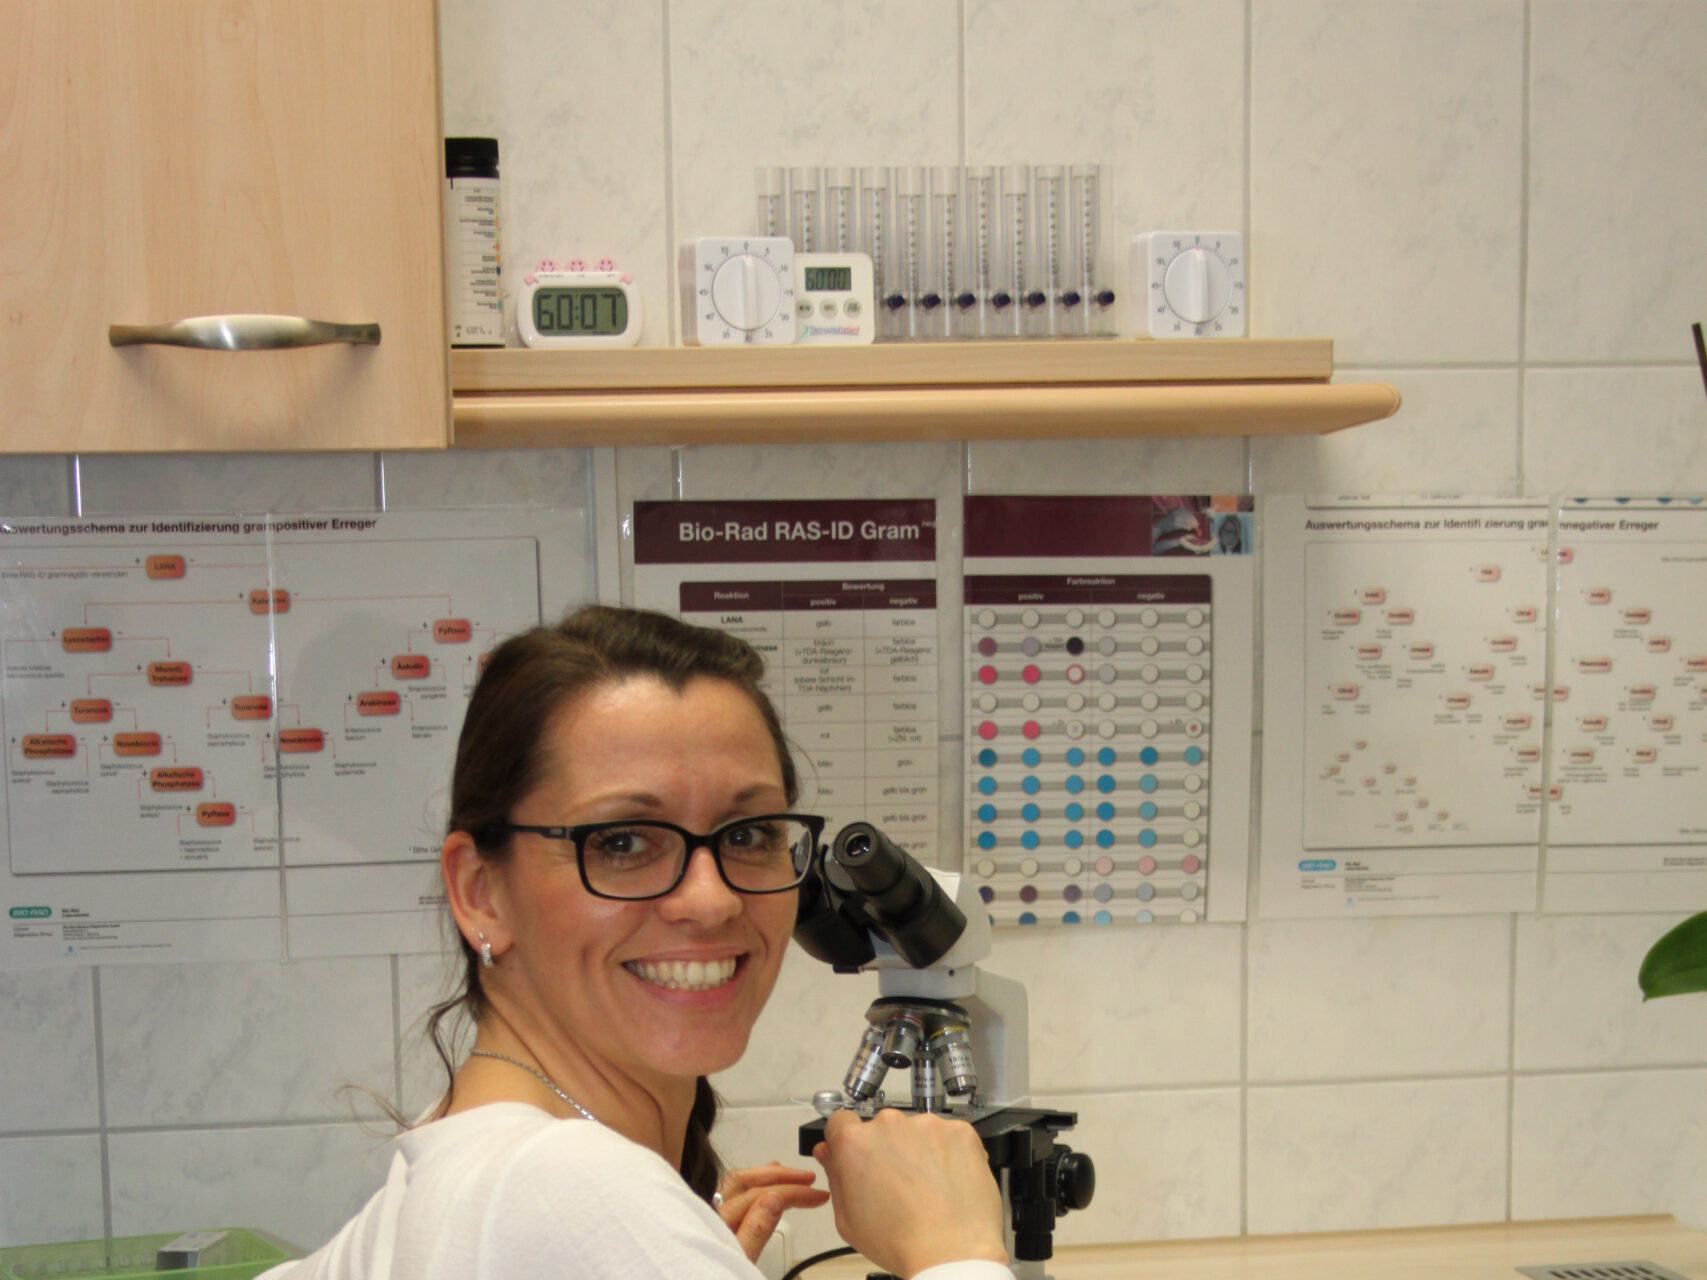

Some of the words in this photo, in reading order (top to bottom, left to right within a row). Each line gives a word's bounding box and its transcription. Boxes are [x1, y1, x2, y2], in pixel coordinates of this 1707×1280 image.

[129, 522, 148, 534] zur
[152, 519, 240, 535] Identifizierung
[332, 517, 377, 531] Erreger
[678, 521, 768, 542] Bio-Rad
[774, 520, 853, 541] RAS-ID
[860, 519, 919, 540] Gram
[1305, 518, 1421, 532] Auswertungsschema
[1423, 520, 1441, 529] zur
[1618, 519, 1659, 533] Erreger
[1066, 577, 1115, 586] Farbreaktion
[842, 582, 885, 592] Bewertung
[714, 591, 749, 600] Reaktion
[1017, 592, 1044, 602] positiv
[1136, 591, 1165, 601] negativ
[810, 597, 837, 607] positiv
[889, 596, 919, 607] negativ
[720, 615, 744, 625] LANA
